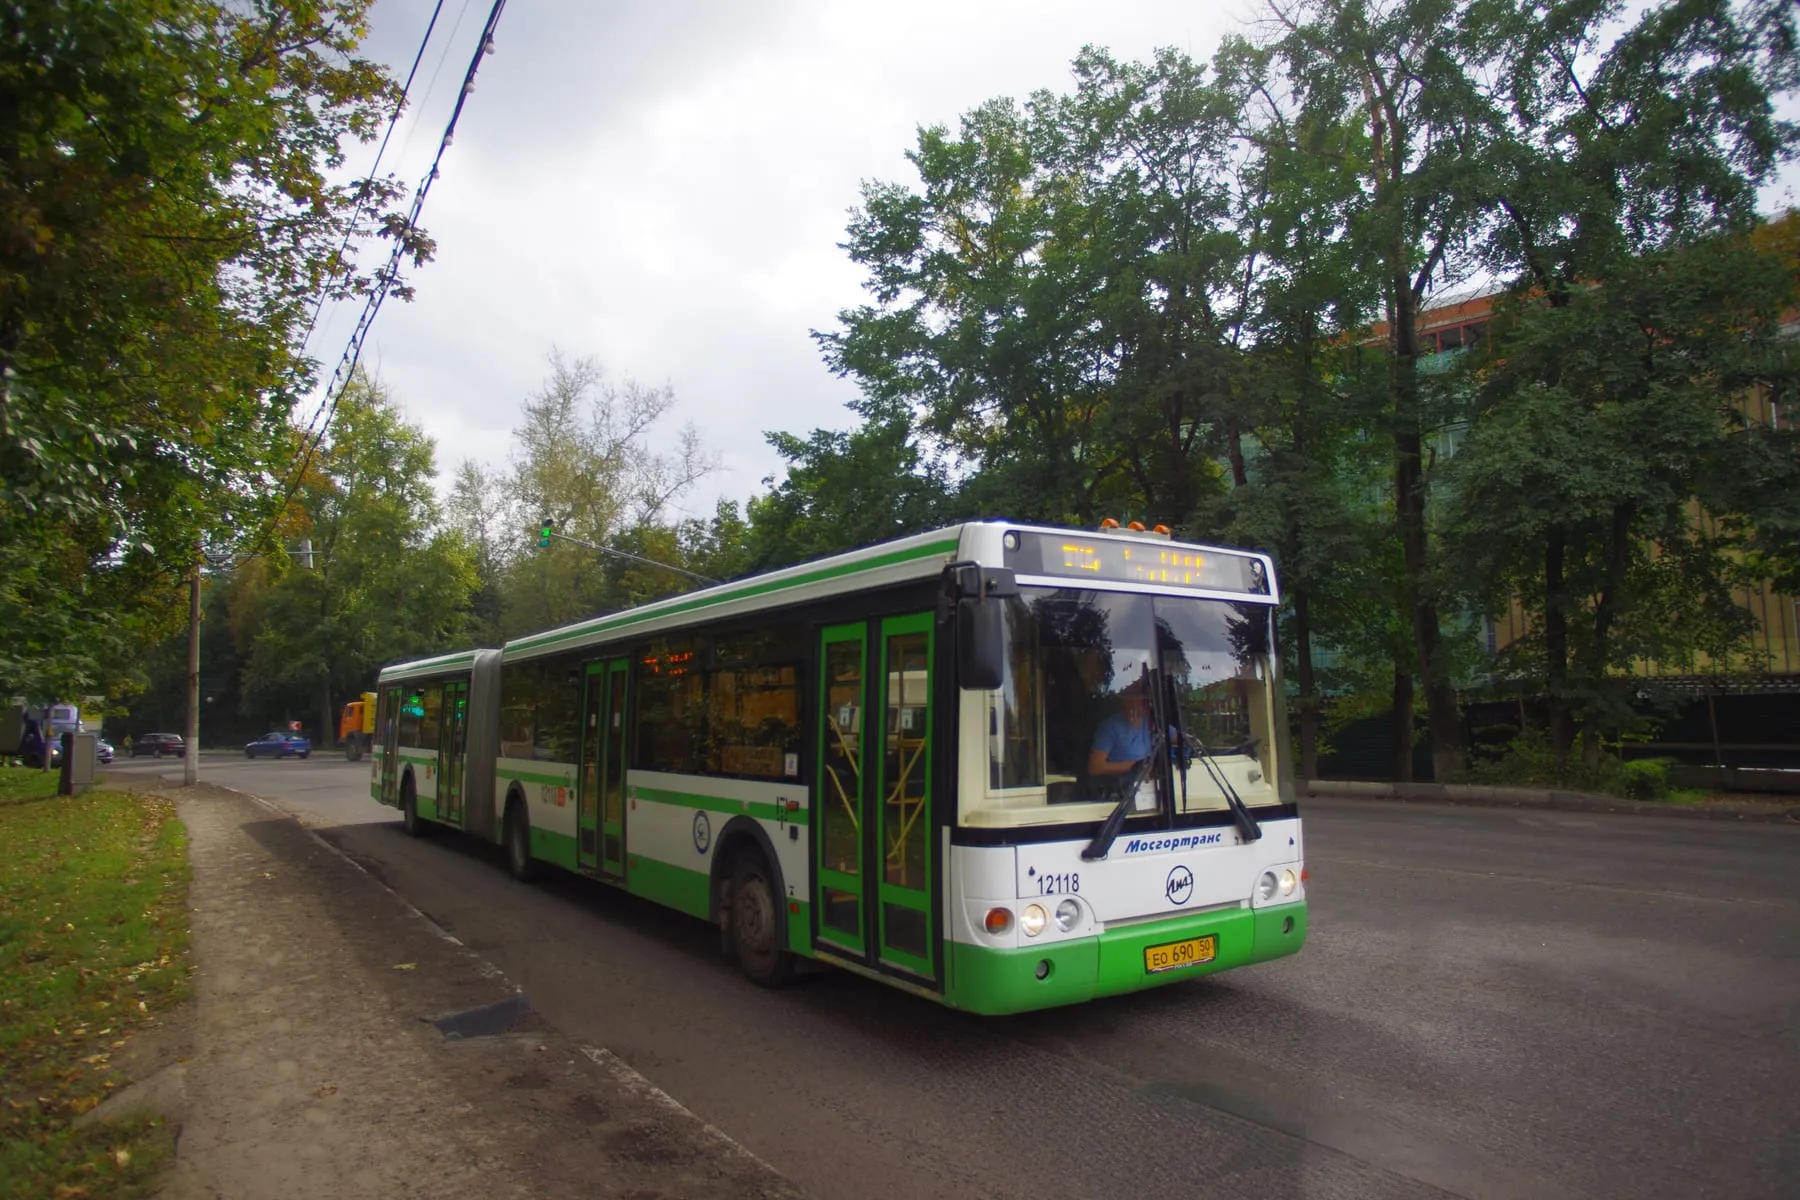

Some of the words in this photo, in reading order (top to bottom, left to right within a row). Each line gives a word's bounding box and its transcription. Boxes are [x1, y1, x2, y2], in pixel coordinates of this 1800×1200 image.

[1124, 833, 1221, 853] Мосгортранс
[1037, 873, 1079, 895] 12118
[1153, 952, 1168, 966] ЕО
[1172, 943, 1194, 962] 690
[1199, 938, 1210, 952] 50
